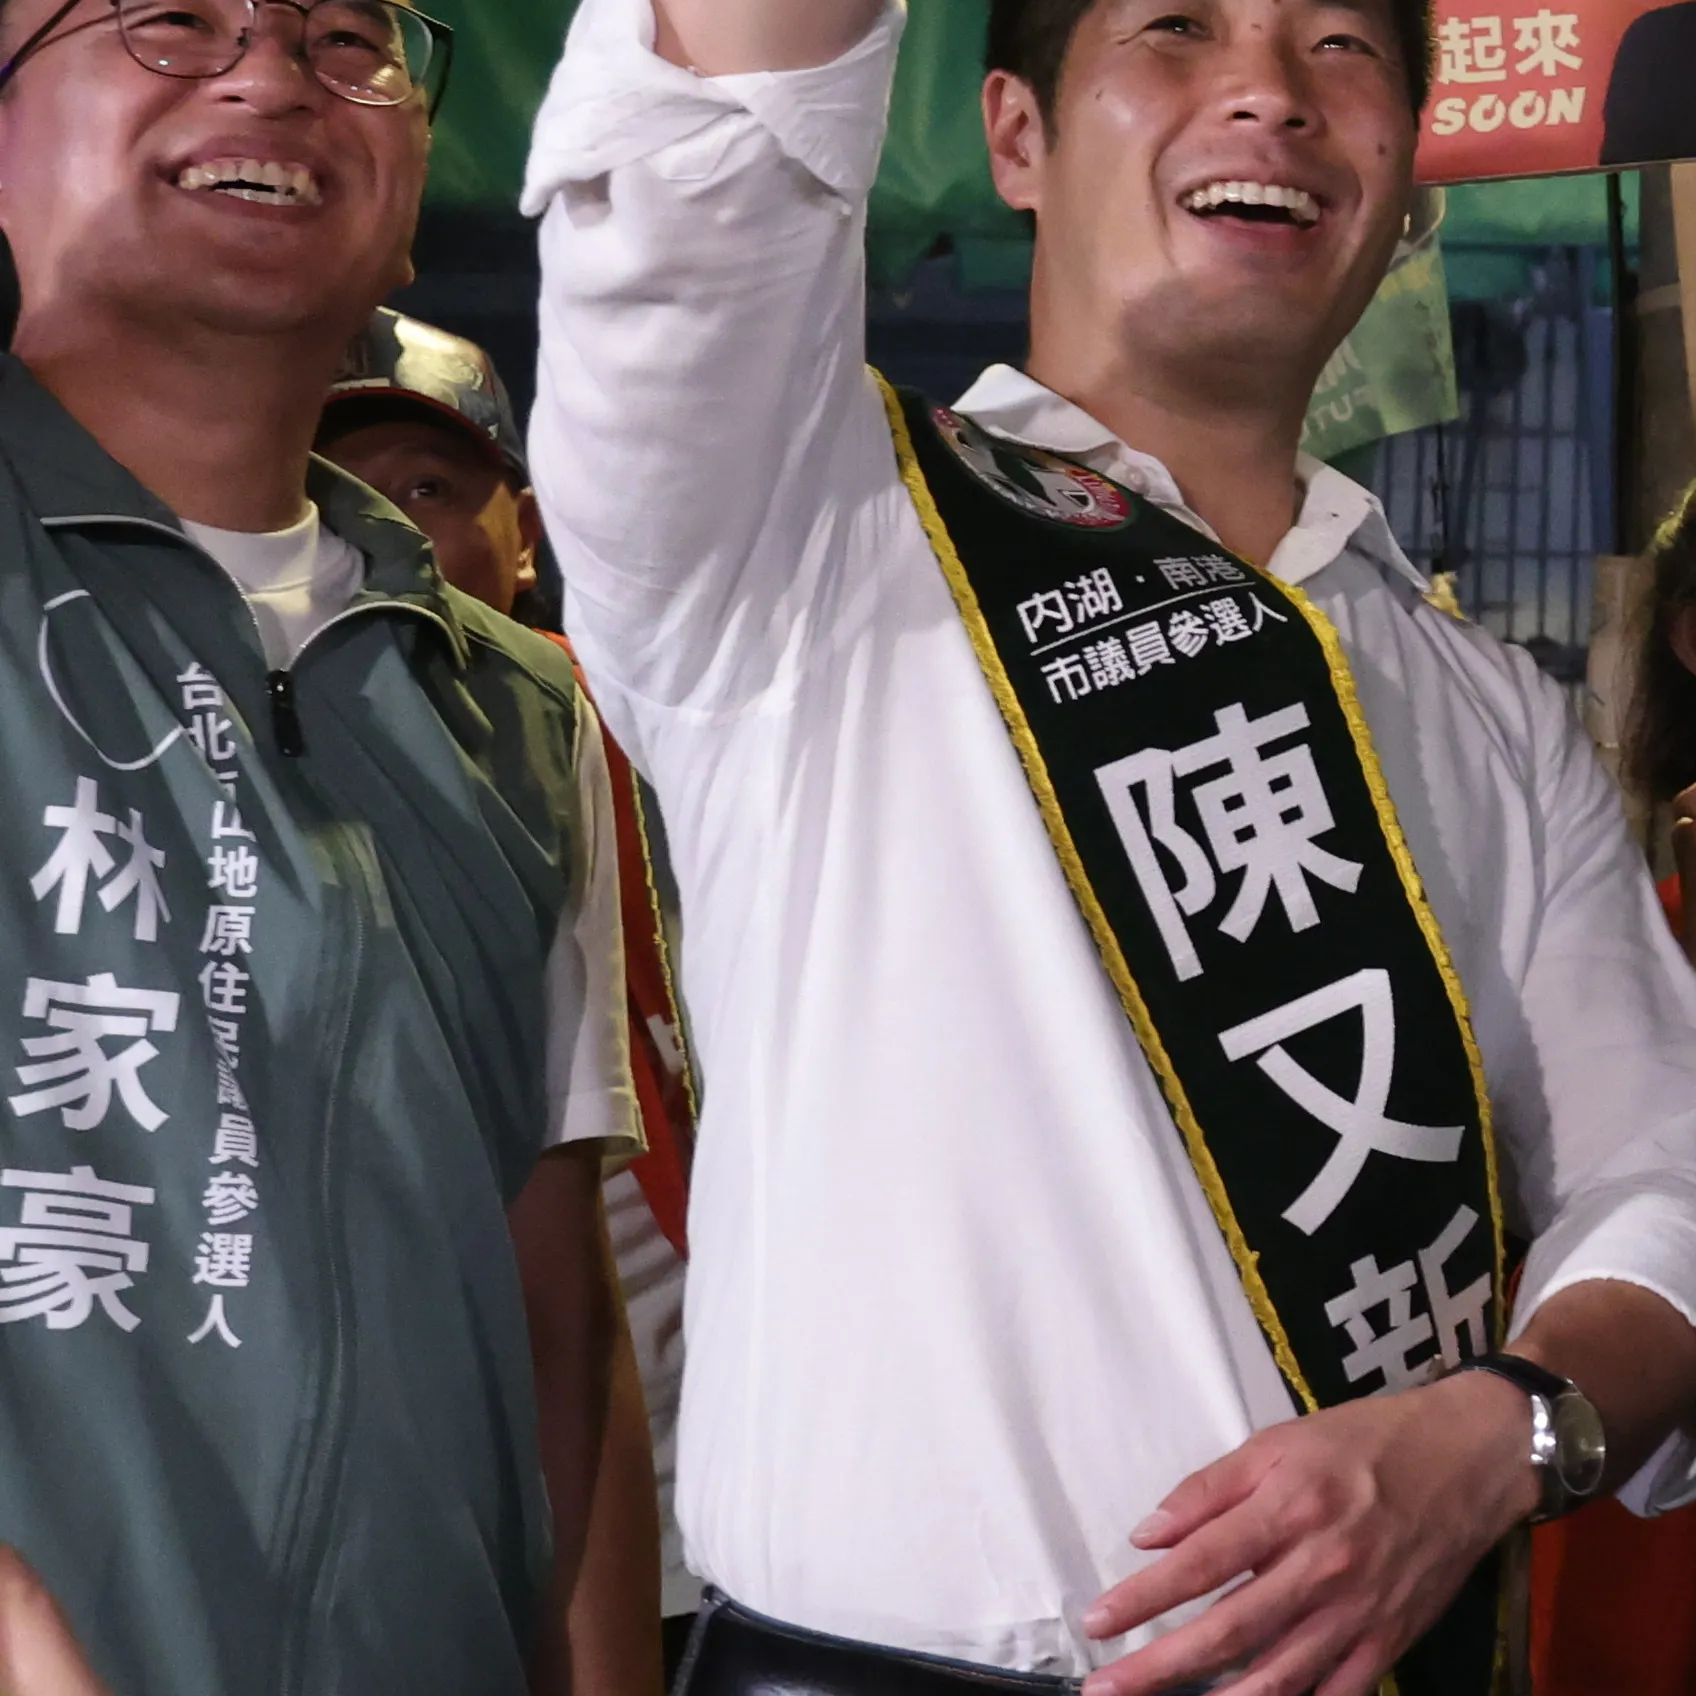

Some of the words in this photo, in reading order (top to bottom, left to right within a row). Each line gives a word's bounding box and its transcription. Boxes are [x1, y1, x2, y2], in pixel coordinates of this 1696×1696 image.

[1431, 87, 1586, 136] SOON
[1039, 591, 1289, 704] 市議員參選人
[0, 776, 181, 1333] 林家豪
[1094, 700, 1494, 1396] 陳又新
